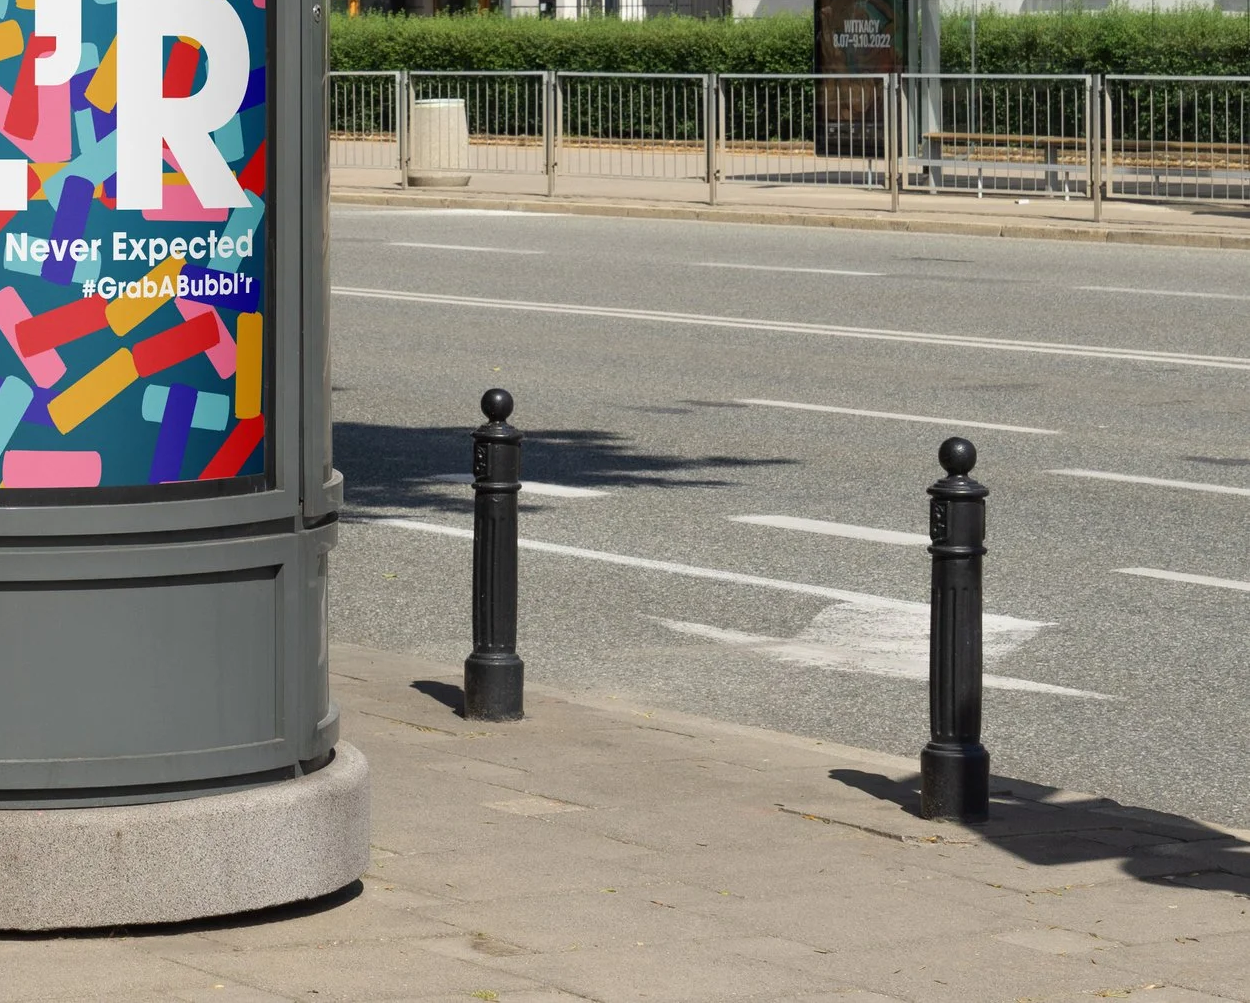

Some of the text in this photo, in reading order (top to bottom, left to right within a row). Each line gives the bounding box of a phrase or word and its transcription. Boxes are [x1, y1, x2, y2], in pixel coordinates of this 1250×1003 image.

[843, 19, 880, 33] WITKACY
[5, 232, 102, 262] Never
[112, 228, 253, 267] Expected
[82, 273, 253, 300] #GrabABubbl'r
